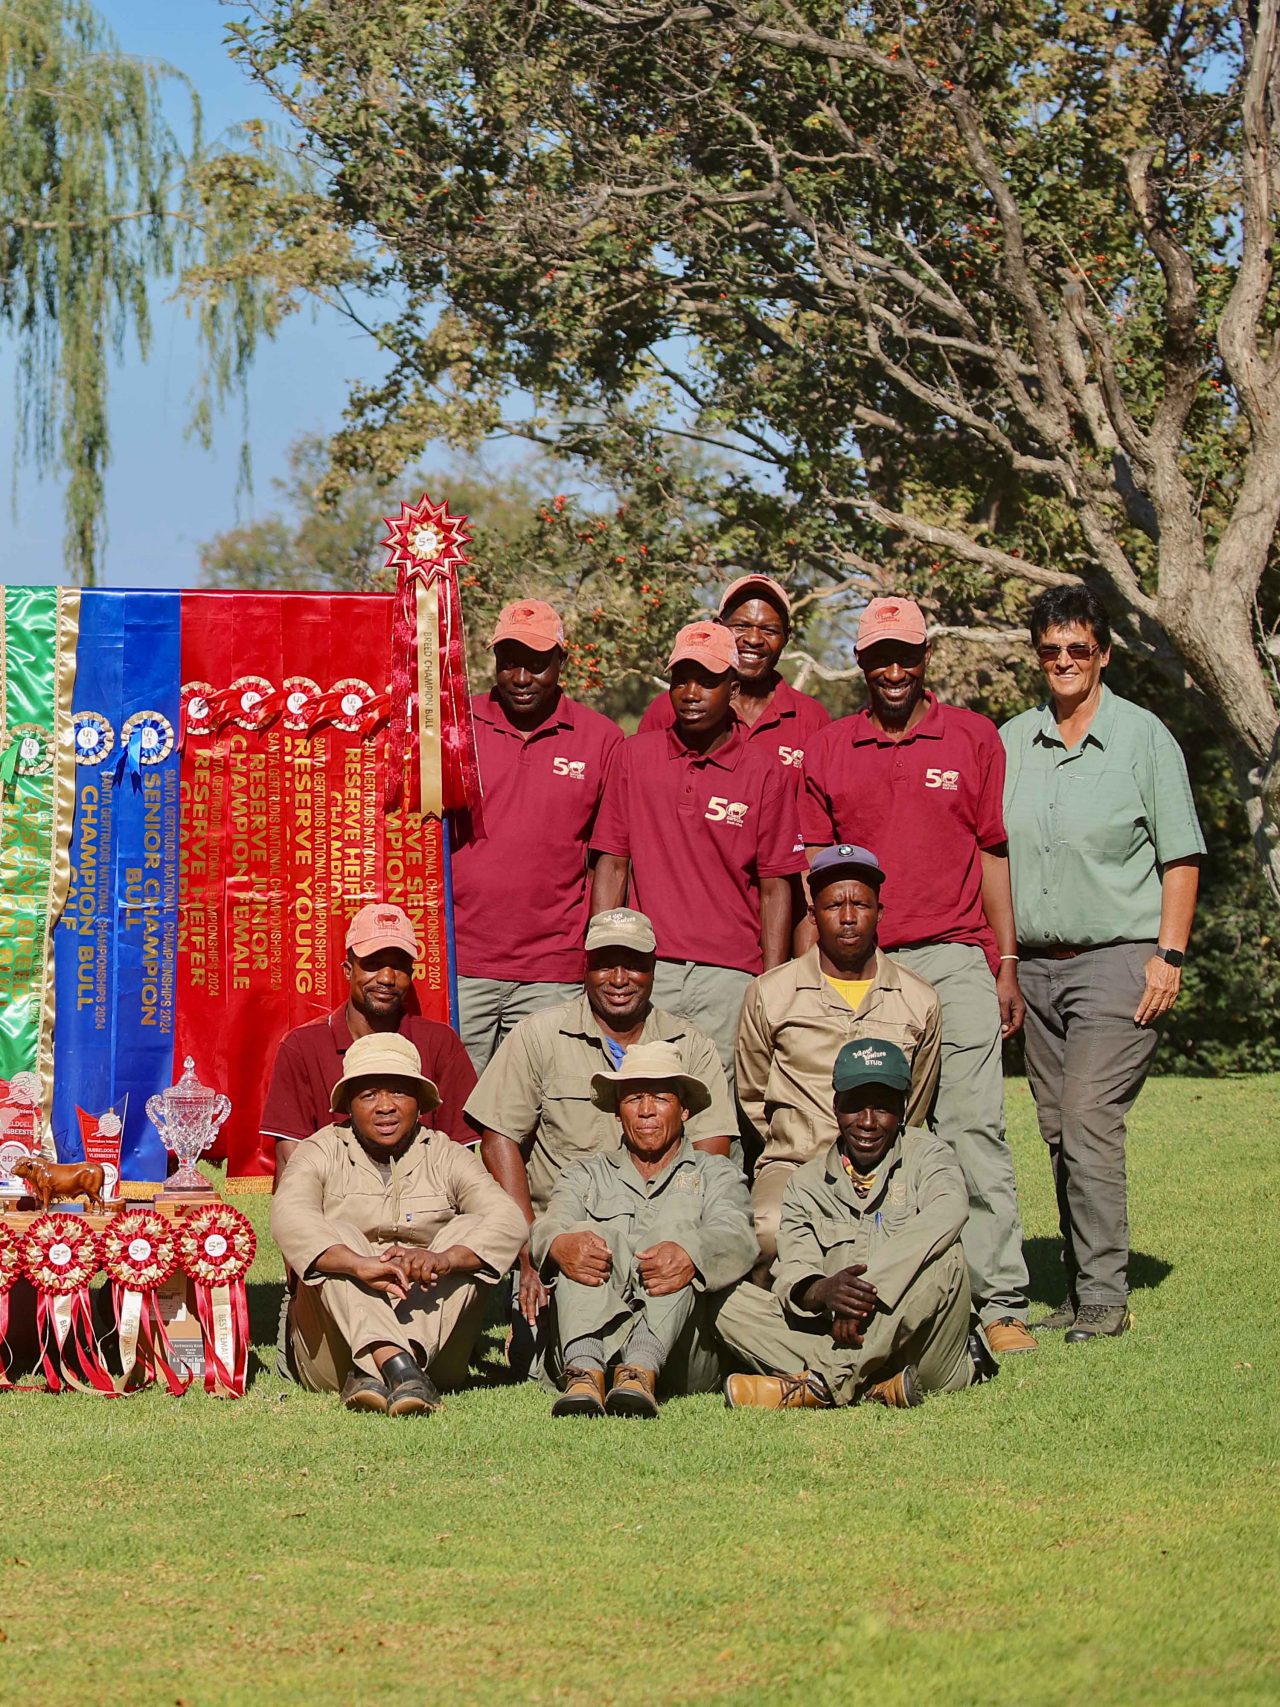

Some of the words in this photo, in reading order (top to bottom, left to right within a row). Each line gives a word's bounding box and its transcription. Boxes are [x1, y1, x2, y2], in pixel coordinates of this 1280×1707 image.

[424, 631, 433, 657] BREED
[424, 659, 433, 706] CHAMPION
[425, 709, 435, 729] BULL
[268, 732, 280, 766] SANTA
[314, 737, 326, 769] SANTA
[164, 769, 176, 804] SANTA
[190, 749, 210, 875] RESERVE
[210, 775, 224, 830] GERTRUDIS
[230, 735, 248, 881] CHAMPION
[250, 754, 267, 862] RESERVE
[268, 768, 281, 823] GERTRUDIS
[294, 738, 312, 865] RESERVE
[314, 772, 326, 827] GERTRUDIS
[344, 748, 361, 841] RESERVE
[363, 771, 376, 826] GERTRUDIS
[100, 808, 112, 862] GERTRUDIS
[143, 773, 161, 869] SENIOR
[164, 805, 176, 861] GERTRUDIS
[78, 785, 98, 936] CHAMPION
[269, 826, 281, 876] NATIONAL
[314, 829, 326, 880] NATIONAL
[363, 828, 377, 877] NATIONAL
[424, 826, 438, 876] NATIONAL
[98, 865, 110, 914] NATIONAL
[125, 868, 142, 931] BULL
[163, 864, 175, 914] NATIONAL
[343, 849, 361, 920] HEIFER
[190, 887, 206, 987] HEIFER
[233, 892, 250, 989] FEMALE
[251, 872, 268, 970] JUNIOR
[270, 878, 282, 963] CHAMPIONSHIPS
[295, 876, 313, 994] YOUNG
[314, 882, 327, 969] CHAMPIONSHIPS
[425, 879, 440, 963] CHAMPIONSHIPS
[77, 946, 94, 1011] BULL
[96, 917, 109, 1003] CHAMPIONSHIPS
[141, 878, 161, 1026] CHAMPION
[160, 922, 175, 1007] CHAMPIONSHIPS
[428, 965, 440, 990] 2024
[207, 972, 219, 996] 2024
[315, 971, 327, 996] 2024
[95, 1005, 106, 1030] 2024
[160, 1009, 171, 1034] 2024
